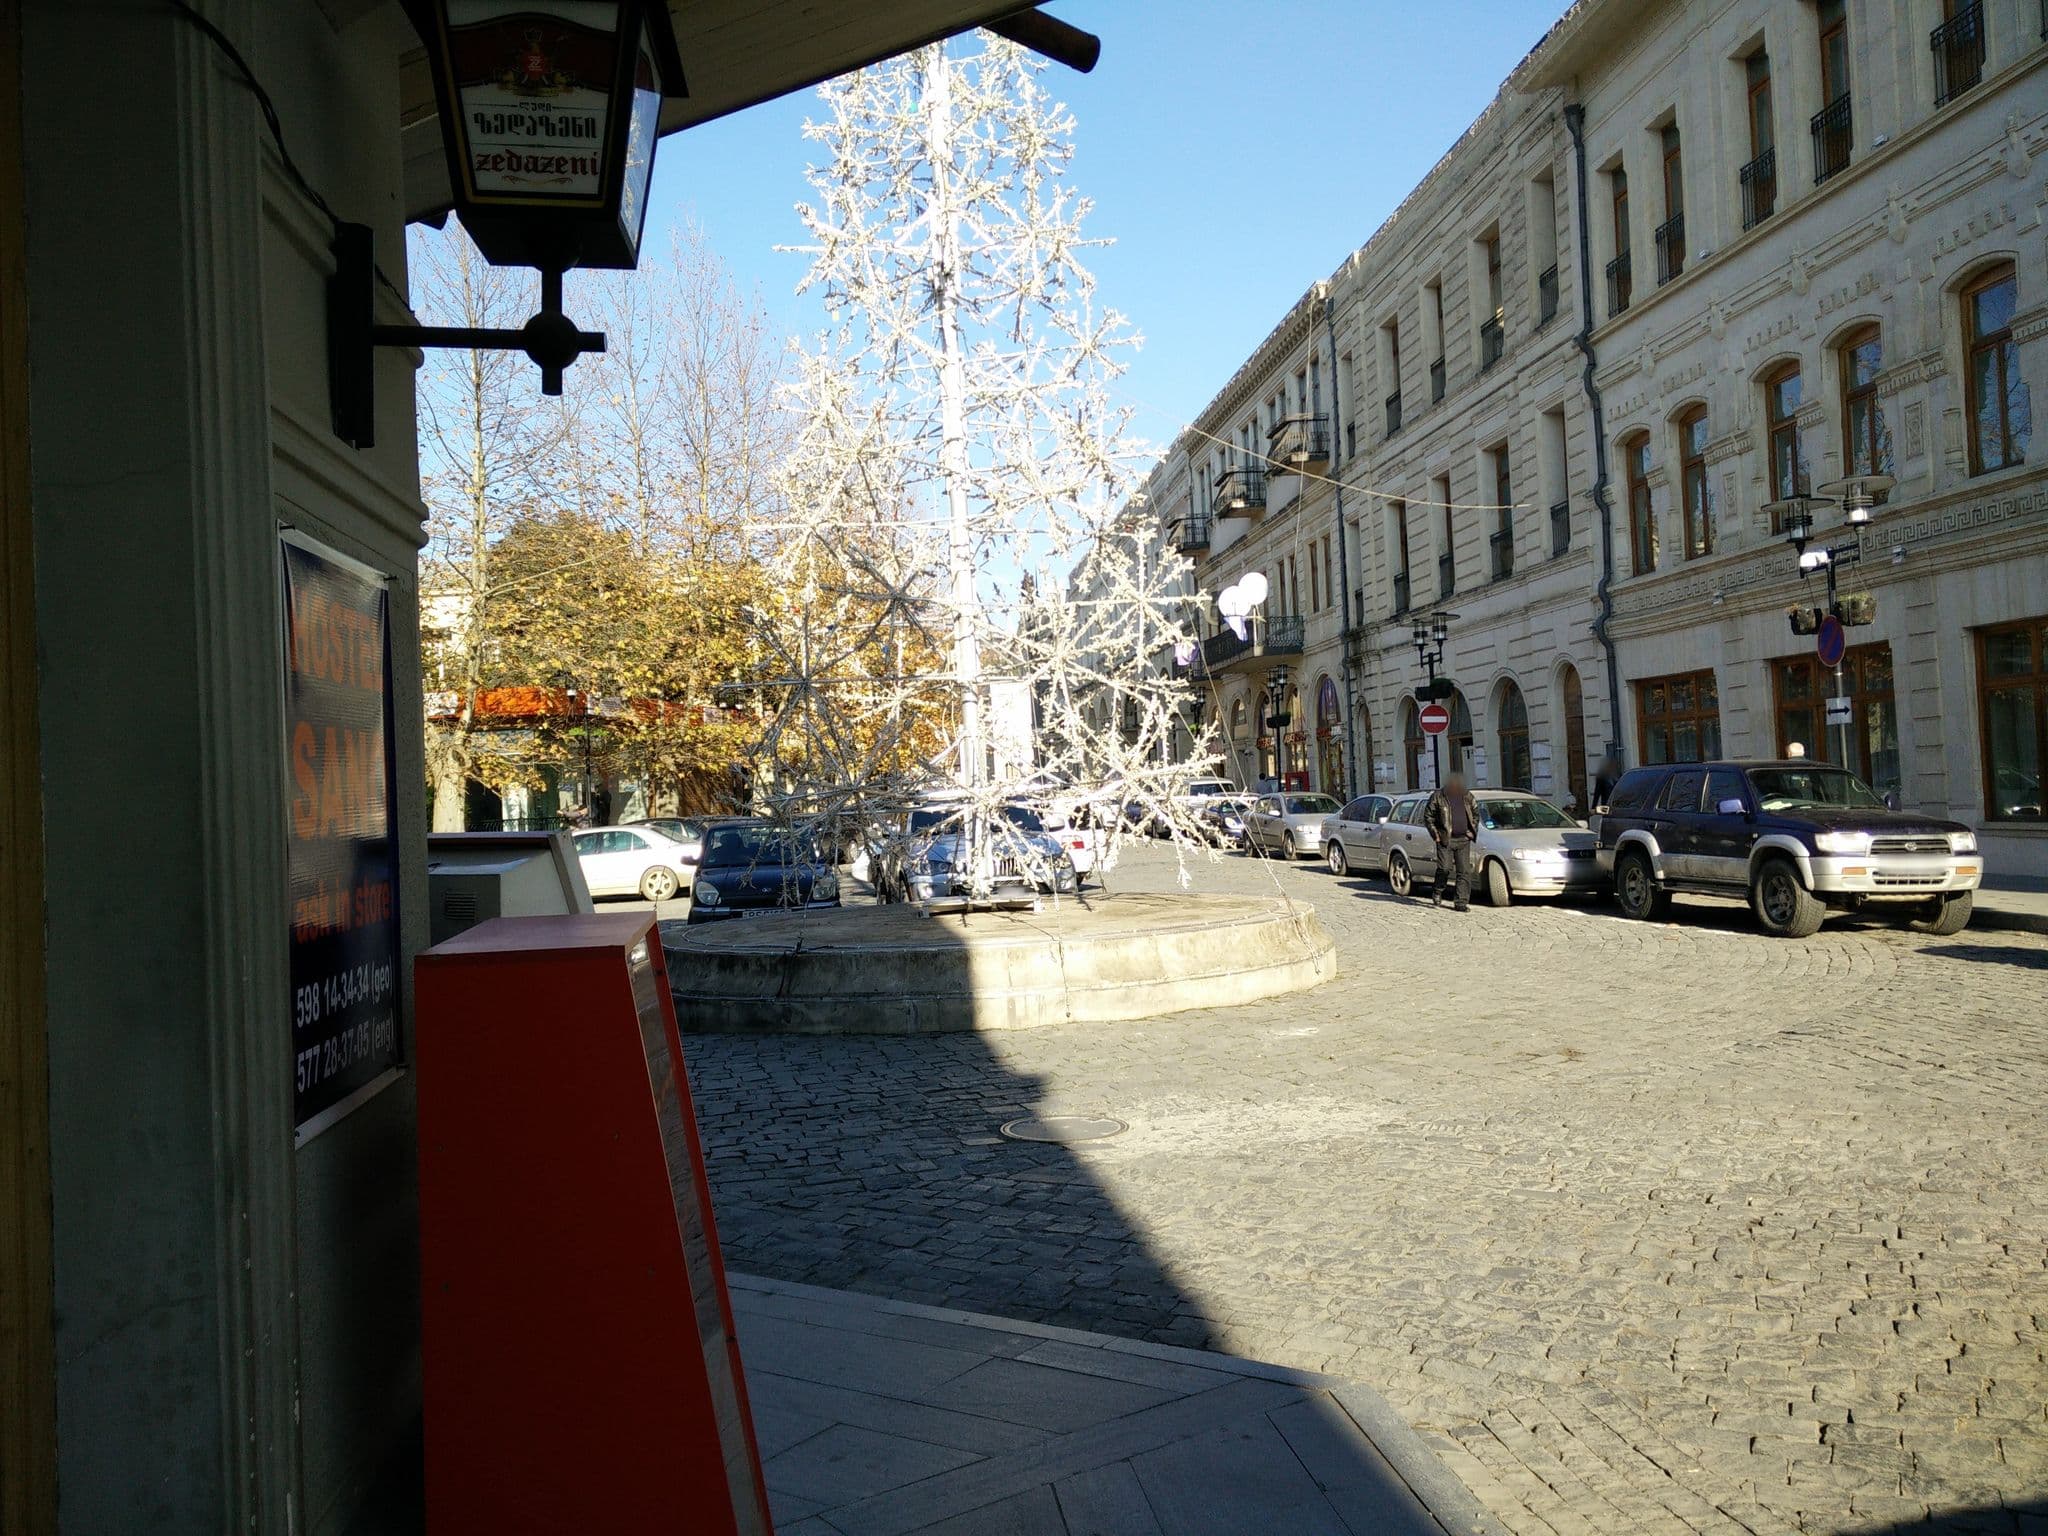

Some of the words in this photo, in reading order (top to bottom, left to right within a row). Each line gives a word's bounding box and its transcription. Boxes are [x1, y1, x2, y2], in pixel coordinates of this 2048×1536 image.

[473, 112, 597, 139] ზედაზენი
[475, 149, 600, 176] zedazeni
[291, 587, 384, 692] HOSTEL
[336, 874, 351, 933] in
[355, 876, 391, 929] store
[296, 981, 320, 1029] 598
[324, 963, 369, 1016] 14-34-34
[371, 954, 393, 1005] (geo)
[296, 1044, 321, 1094] 577
[372, 1008, 394, 1061] (eng)
